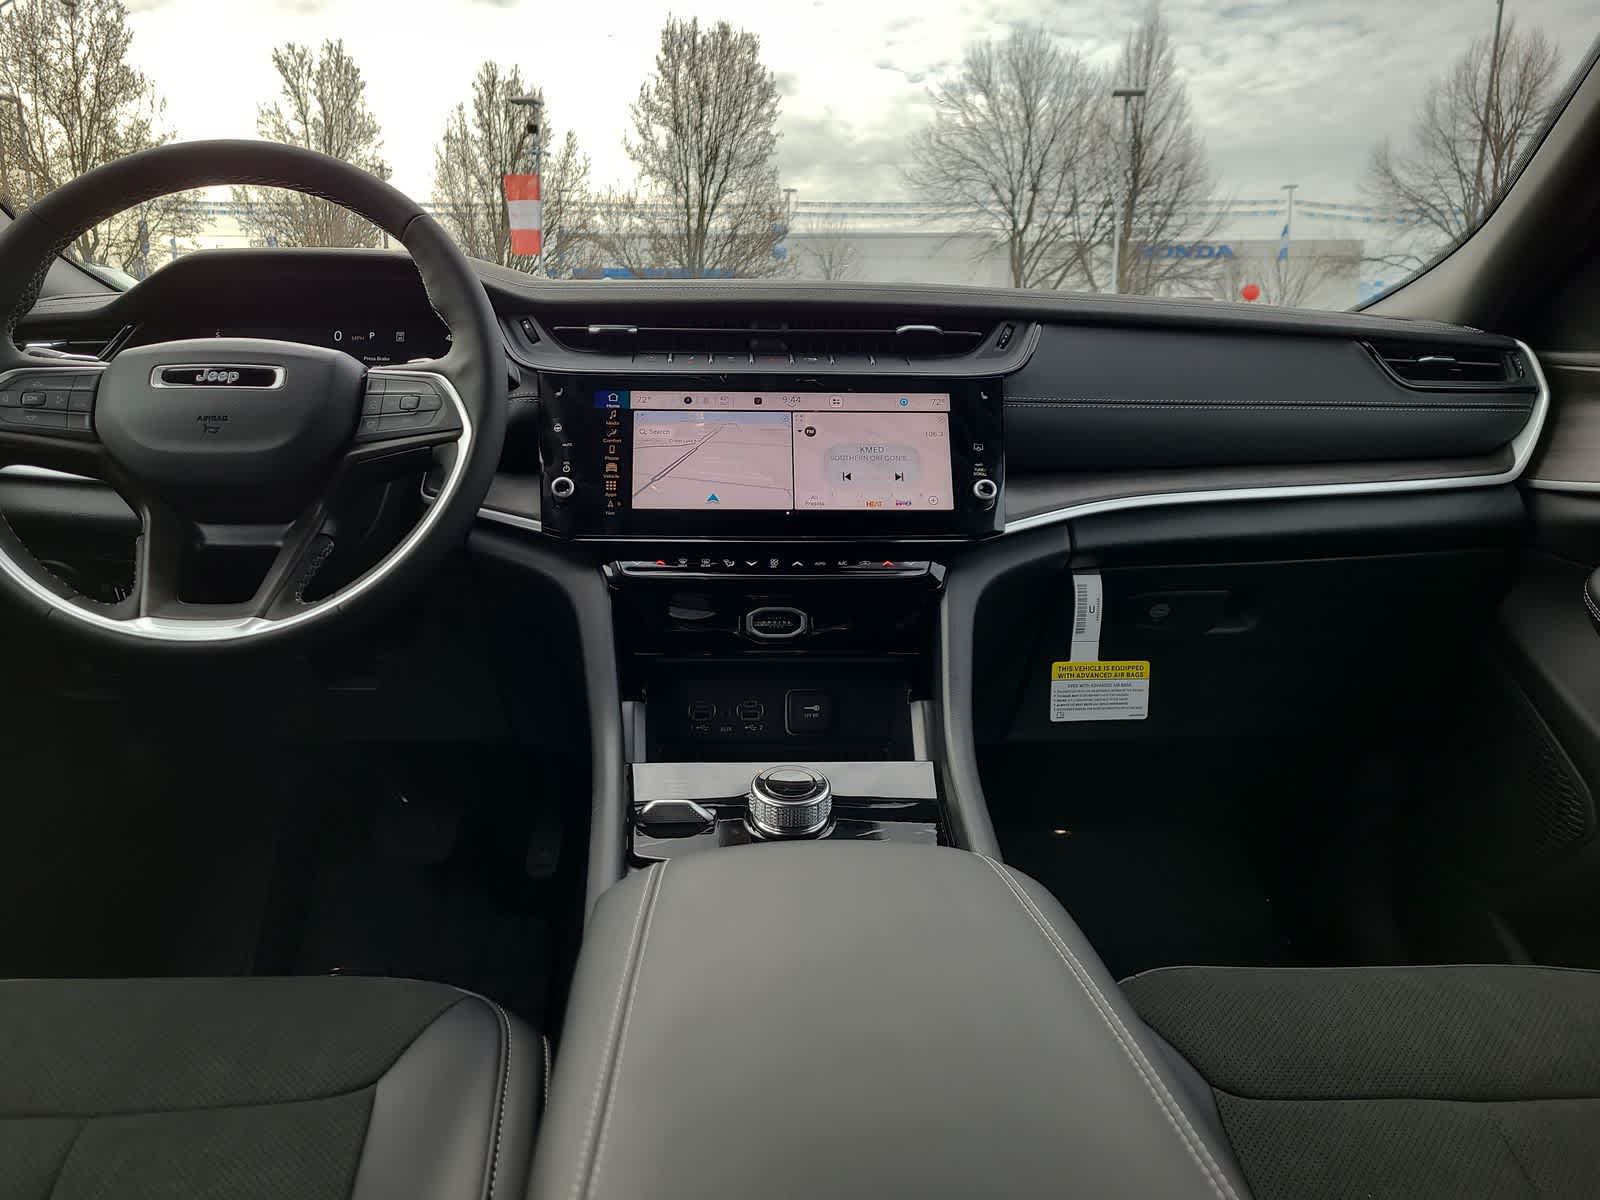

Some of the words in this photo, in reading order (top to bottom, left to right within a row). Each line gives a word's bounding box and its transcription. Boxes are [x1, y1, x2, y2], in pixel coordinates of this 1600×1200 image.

[369, 331, 376, 341] P
[195, 367, 241, 384] Jeep
[196, 415, 229, 423] AIRBAG
[1057, 665, 1073, 673] THIS
[1074, 665, 1101, 673] VEHICLE
[1057, 672, 1075, 680] WITH
[1114, 671, 1126, 679] AIR
[1126, 671, 1145, 679] BAGS
